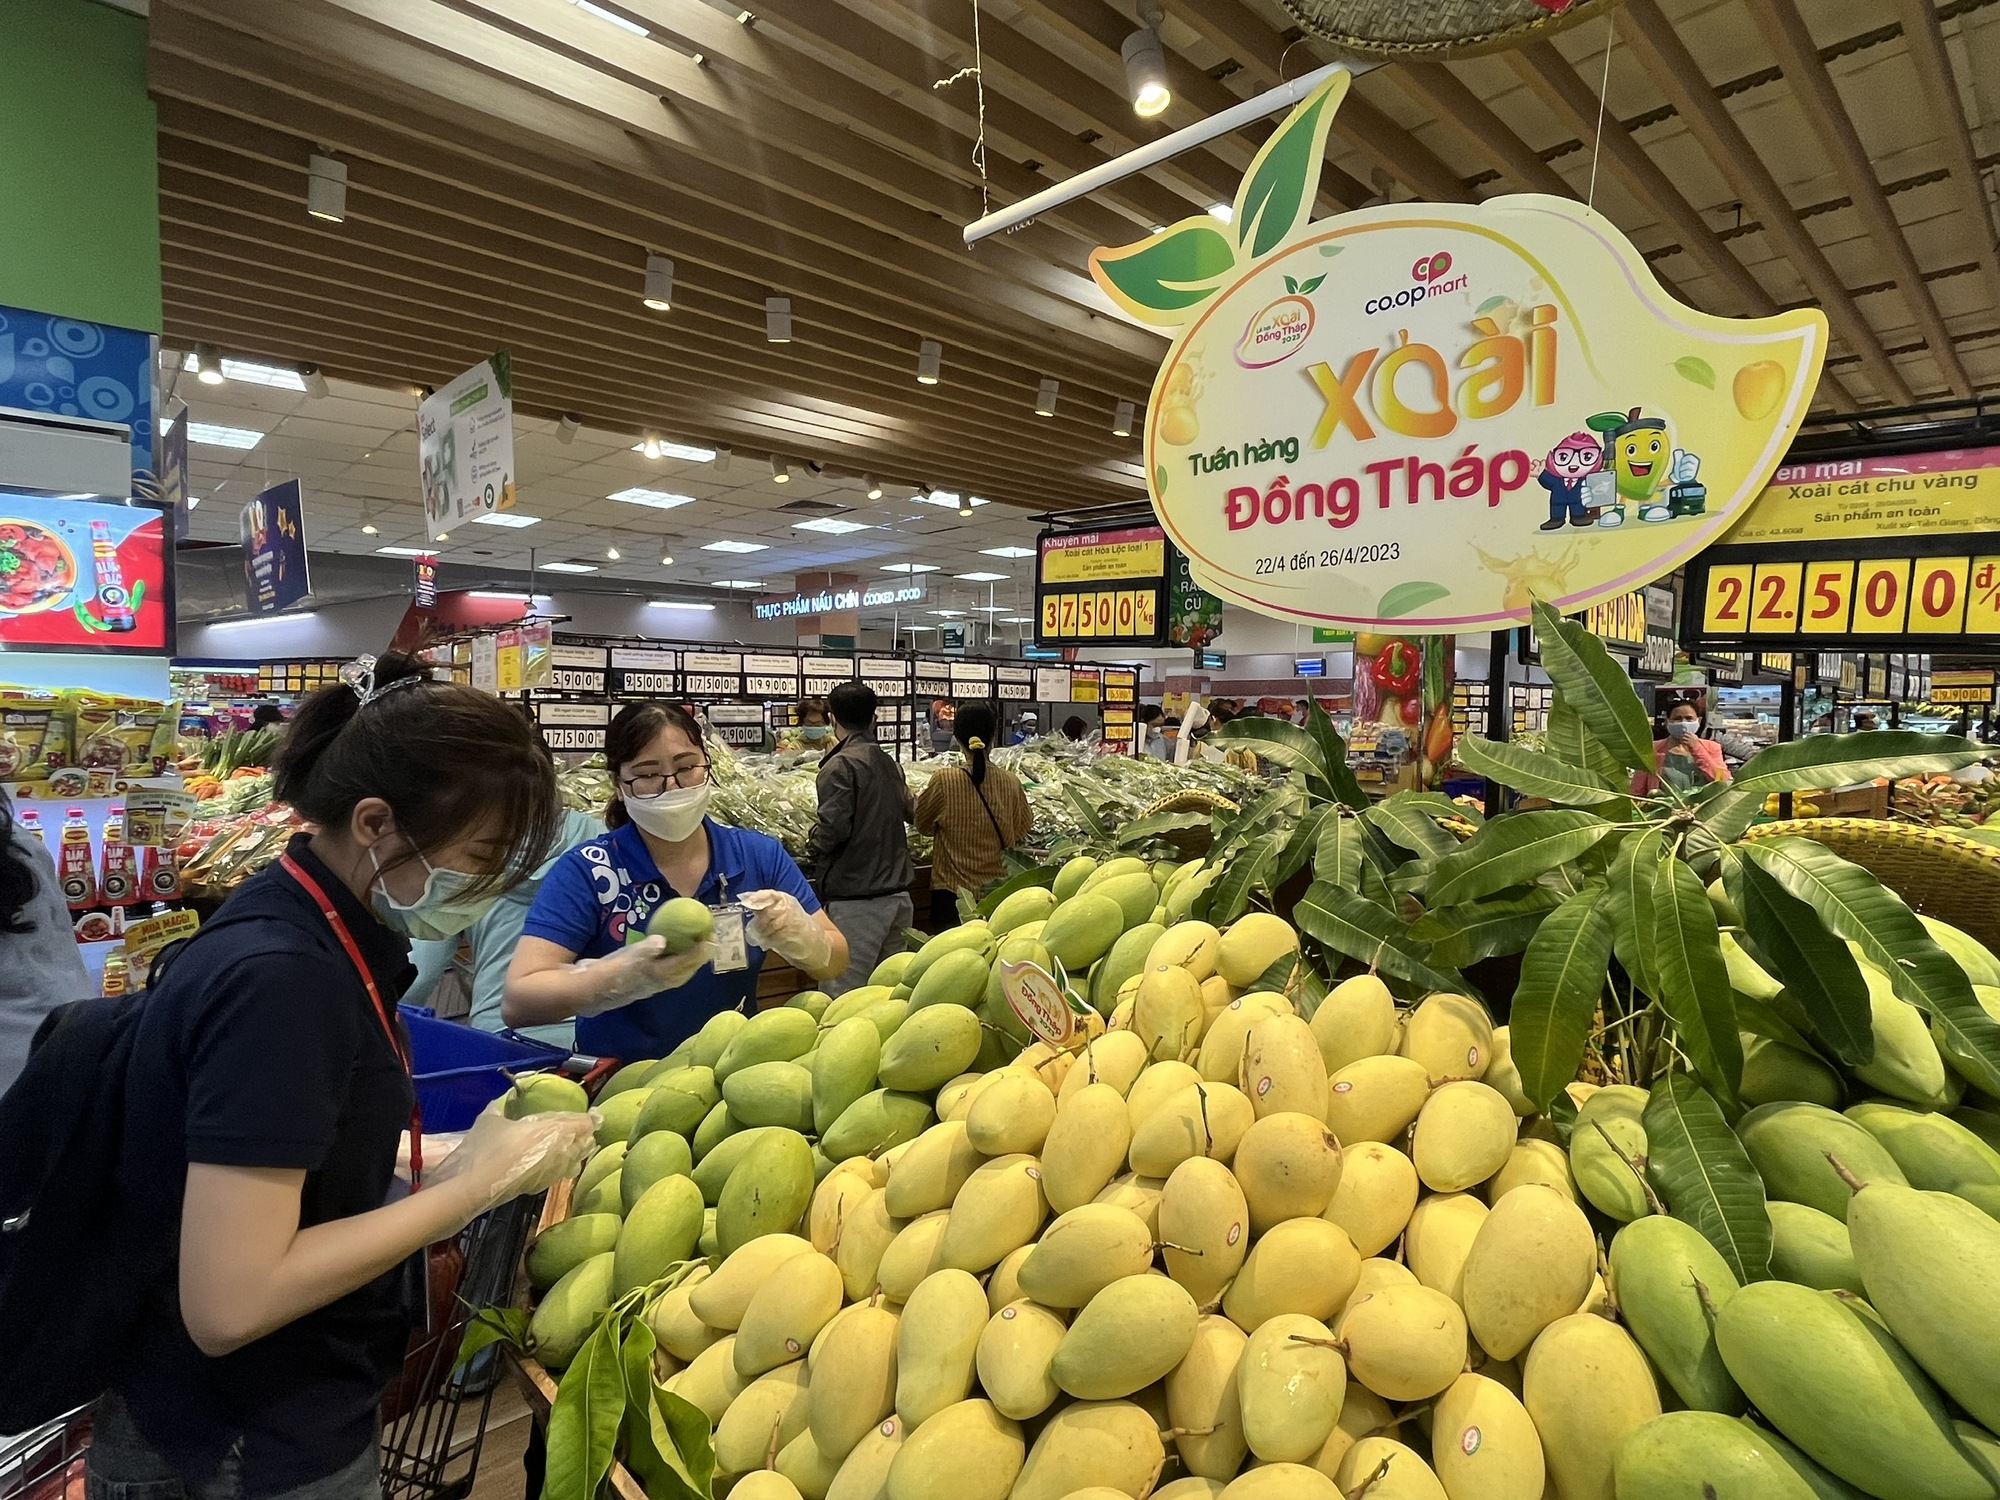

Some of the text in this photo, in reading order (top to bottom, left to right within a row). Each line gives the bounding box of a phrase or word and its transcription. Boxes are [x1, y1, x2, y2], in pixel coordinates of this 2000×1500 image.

[1282, 323, 1307, 336] Tháp
[1282, 333, 1301, 344] 2023
[1244, 437, 1299, 465] hàng
[1225, 444, 1530, 530] Đồng Tháp
[1788, 473, 1979, 500] Xoài cát chu vàng
[1814, 506, 1941, 523] Sản phẩm an toàn
[1064, 549, 1080, 558] Xoài
[1081, 547, 1093, 557] cát
[1112, 544, 1126, 556] Lộc
[1145, 543, 1149, 551] 1
[1255, 542, 1400, 575] 22/4 đến 26/4/2023
[1715, 569, 1956, 620] 22.500
[756, 604, 781, 621] THỰC
[782, 593, 810, 616] PHẨM
[812, 590, 833, 612] NẤU
[834, 589, 860, 609] CHÍN
[898, 588, 921, 602] FOOD
[1045, 594, 1154, 629] 37.500 đ/kg
[626, 675, 662, 689] 9.500
[690, 677, 730, 690] 17.500
[750, 679, 787, 692] 19.900
[808, 681, 836, 692] 11.20
